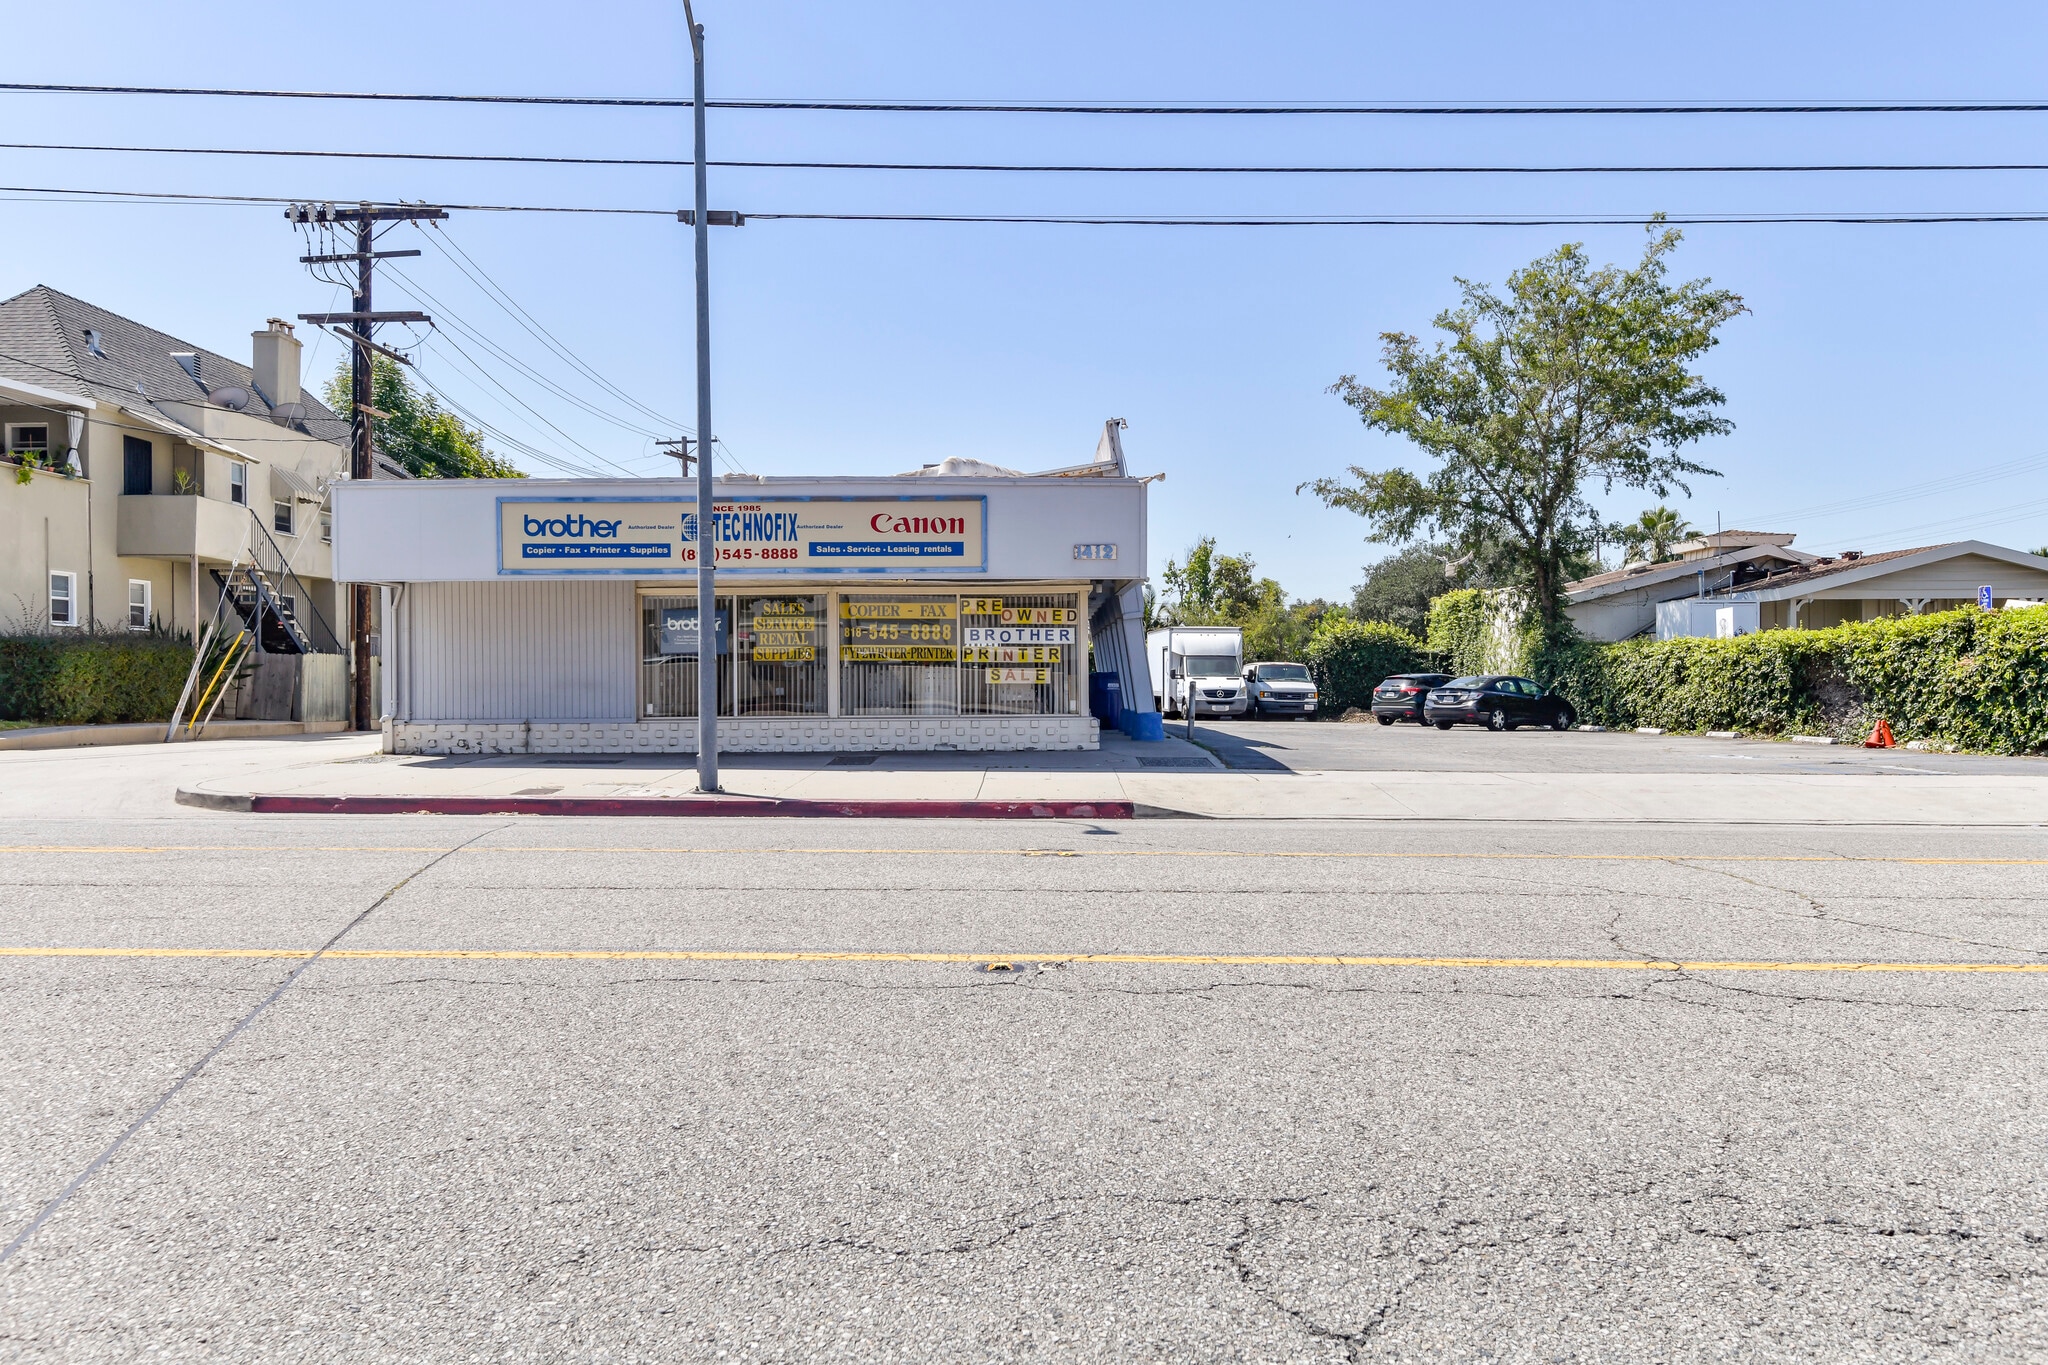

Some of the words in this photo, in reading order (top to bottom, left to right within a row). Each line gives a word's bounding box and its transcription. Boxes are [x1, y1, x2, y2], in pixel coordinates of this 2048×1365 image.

[524, 514, 622, 538] brother
[713, 513, 798, 541] TECHNOFIX
[870, 514, 964, 534] Canon
[526, 546, 556, 555] Copier
[630, 546, 668, 555] Supplies
[682, 548, 798, 561] (8)545-8888
[888, 546, 920, 554] Leasing
[763, 603, 805, 615] SALES
[848, 604, 900, 617] COPIER
[920, 605, 947, 616] FAX
[961, 600, 1002, 612] PRE
[1001, 608, 1077, 623] OWNED
[668, 617, 722, 631] brotr
[756, 618, 812, 630] SERVICE
[760, 633, 808, 645] RENTAL
[844, 624, 952, 640] 818-545-8888
[970, 628, 1070, 642] BROTHER
[756, 647, 812, 660] SUPPLIES
[842, 646, 953, 660] TYPEWRITER-PRINTER
[964, 648, 1060, 662] PRINTER
[991, 668, 1046, 682] SALE
